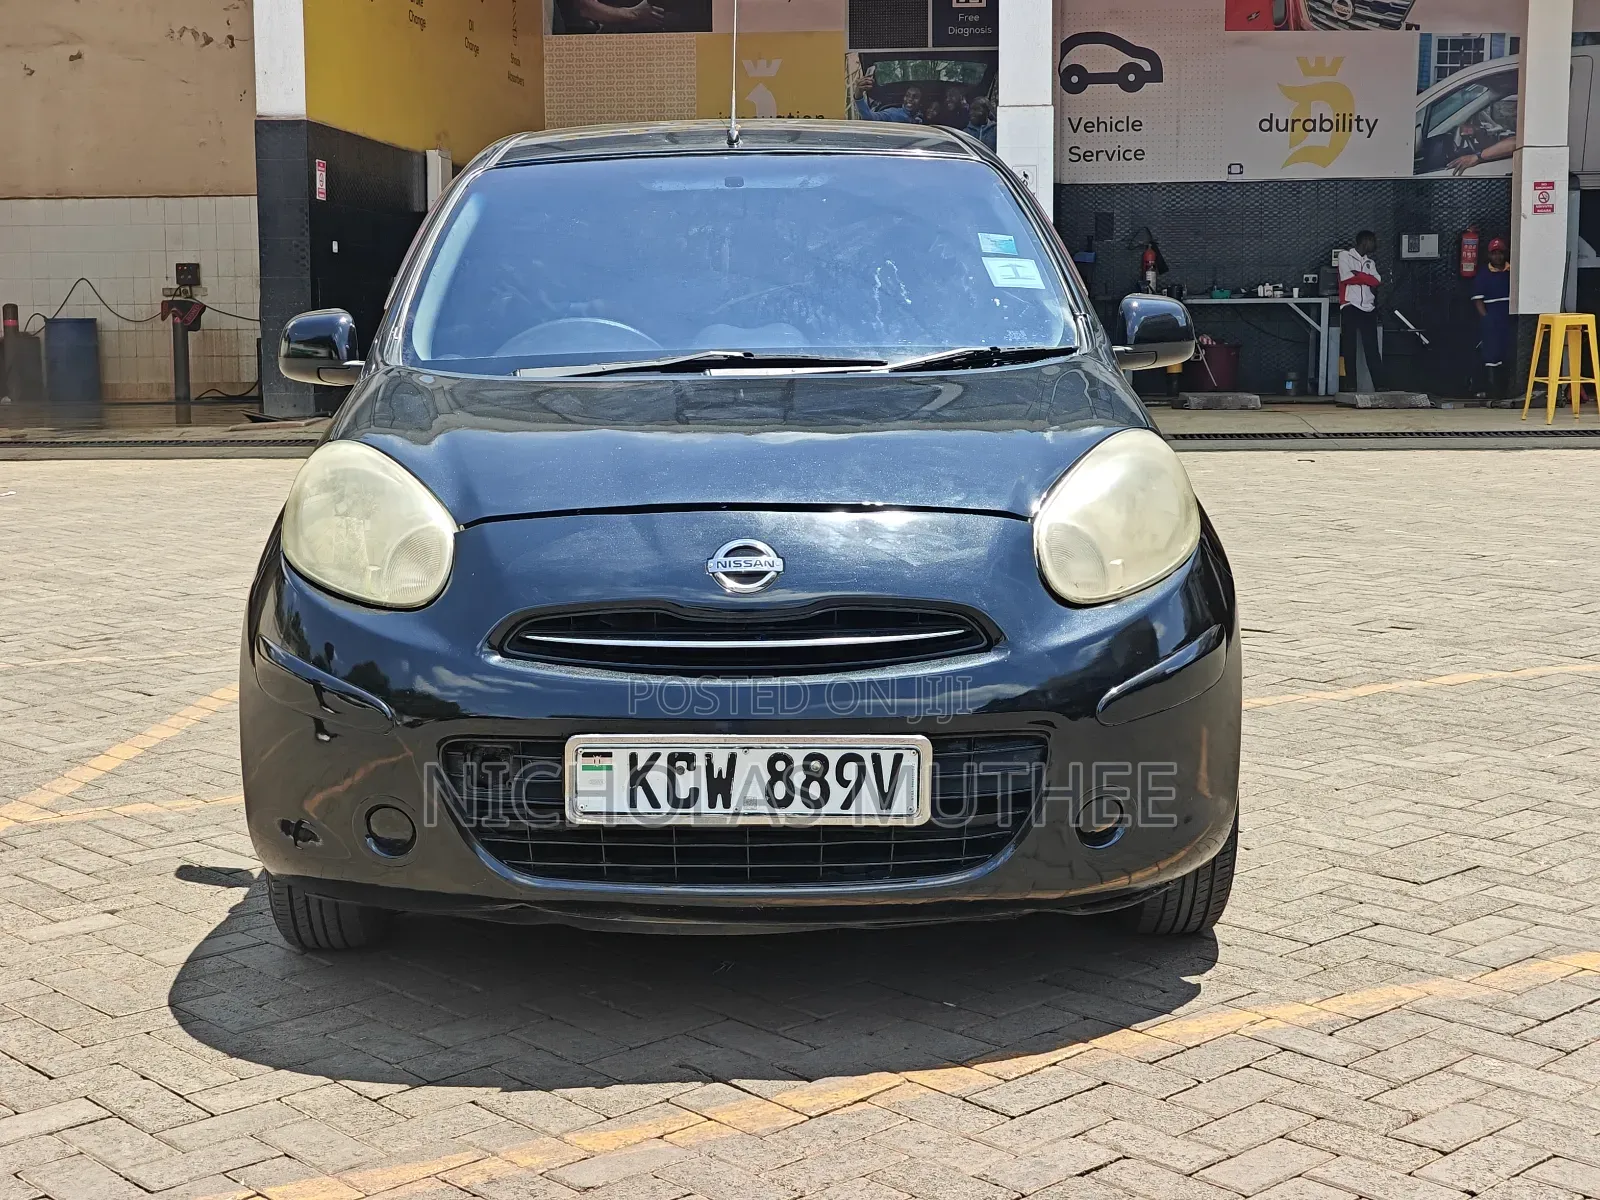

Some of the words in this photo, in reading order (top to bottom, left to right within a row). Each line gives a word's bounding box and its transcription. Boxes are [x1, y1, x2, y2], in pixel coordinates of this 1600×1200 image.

[408, 9, 426, 31] Change
[958, 13, 980, 22] Free
[948, 26, 992, 37] Diagnosis
[1067, 115, 1143, 134] Vehicle
[1258, 113, 1379, 139] durability
[1068, 145, 1146, 163] Service
[716, 560, 775, 569] NISSAN
[628, 751, 738, 810] KCW
[764, 751, 905, 811] 889V
